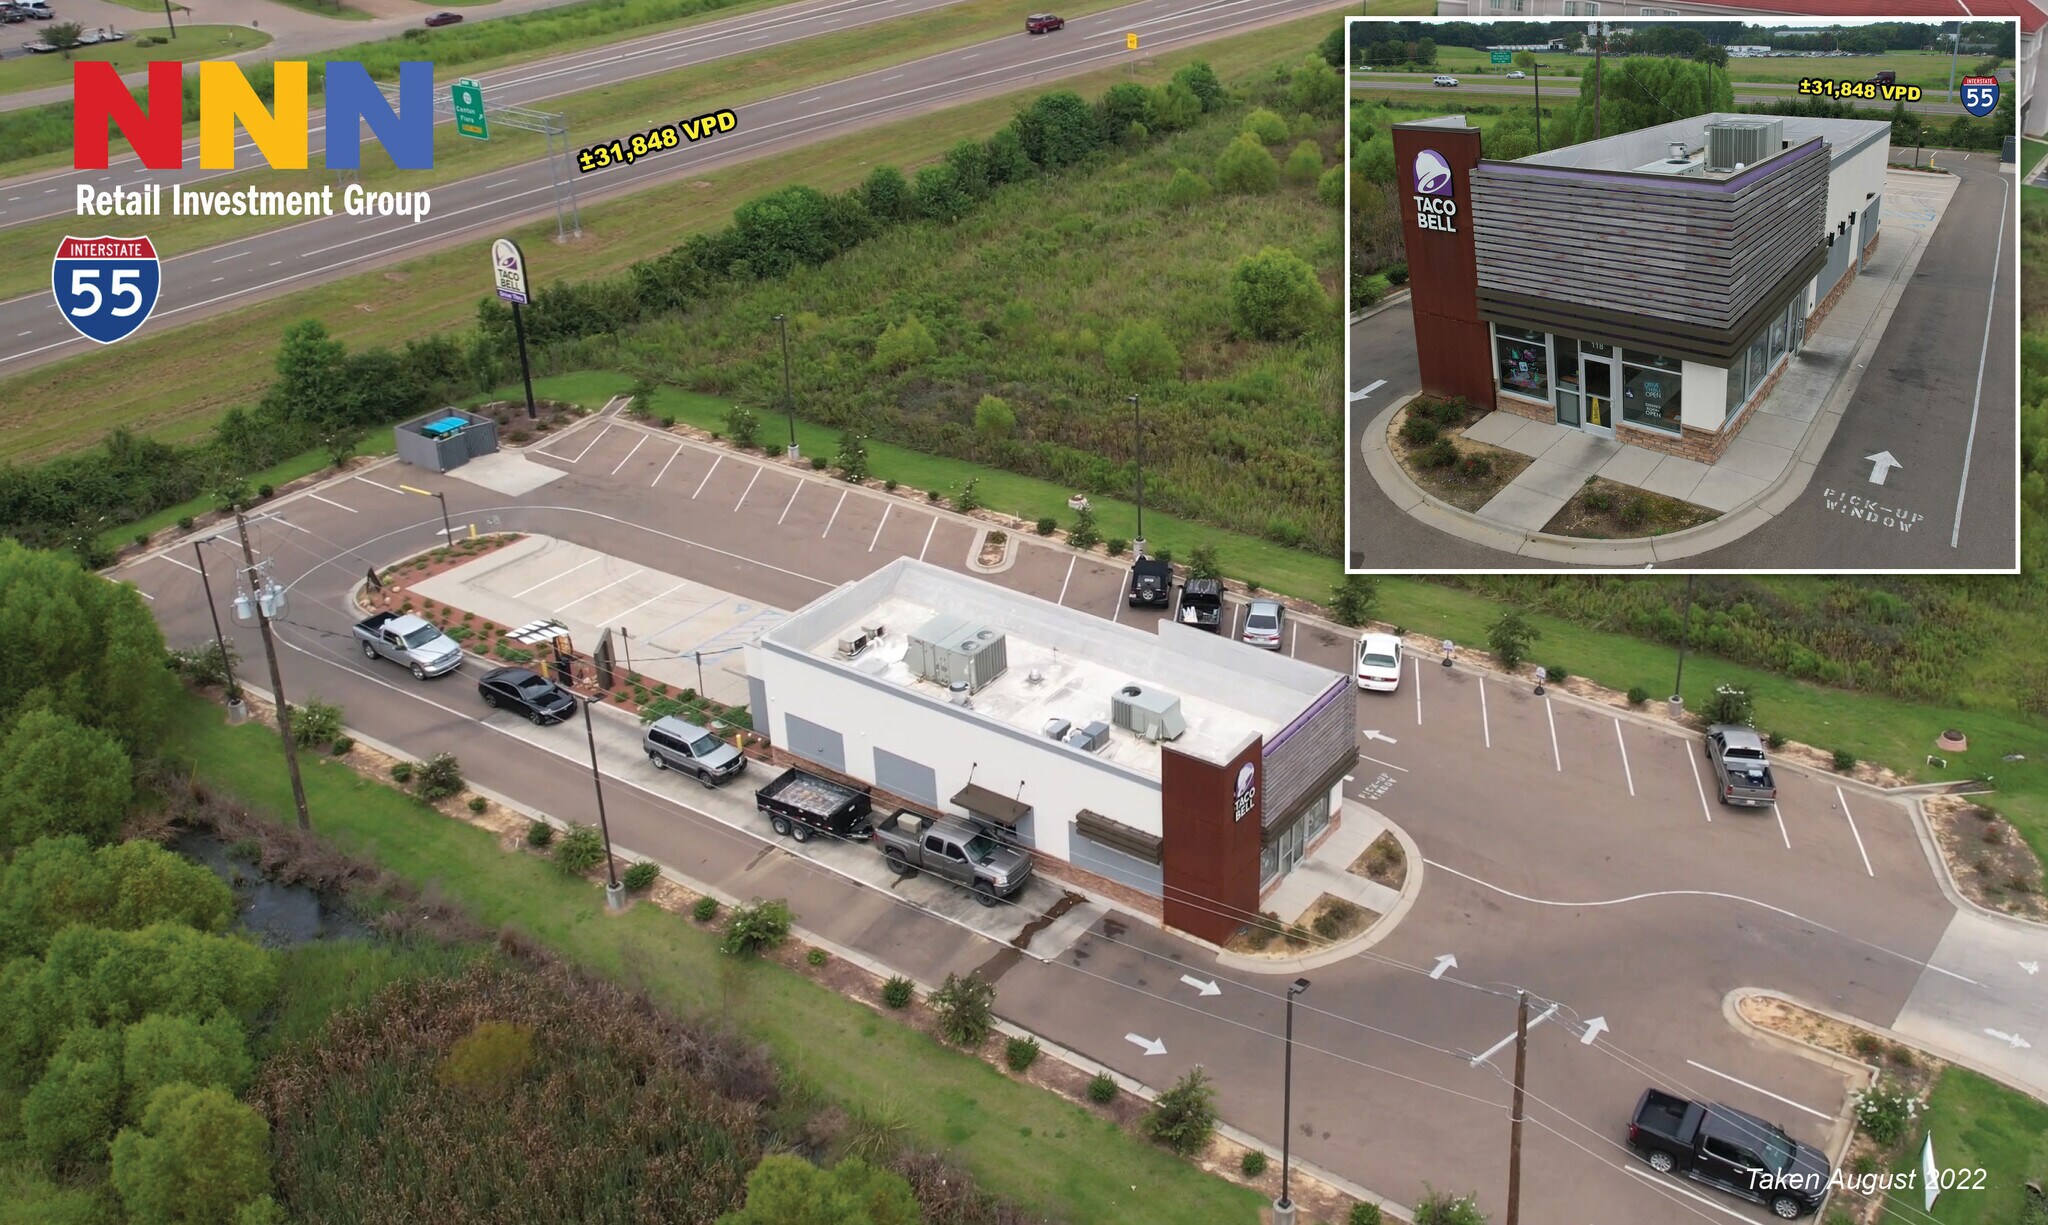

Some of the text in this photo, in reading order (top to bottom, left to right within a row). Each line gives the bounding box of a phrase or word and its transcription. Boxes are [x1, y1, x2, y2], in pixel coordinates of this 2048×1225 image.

[1413, 195, 1457, 216] TACO
[1417, 212, 1457, 233] BELL
[497, 268, 520, 281] TACO
[500, 278, 521, 291] BELL
[1591, 341, 1604, 350] 118
[1645, 391, 1662, 399] OPEN
[1645, 410, 1661, 418] OPEN
[1823, 487, 1925, 523] PICK-UP
[1826, 499, 1913, 533] WINDOW
[1234, 786, 1256, 811] TACO
[1235, 799, 1255, 822] BELL
